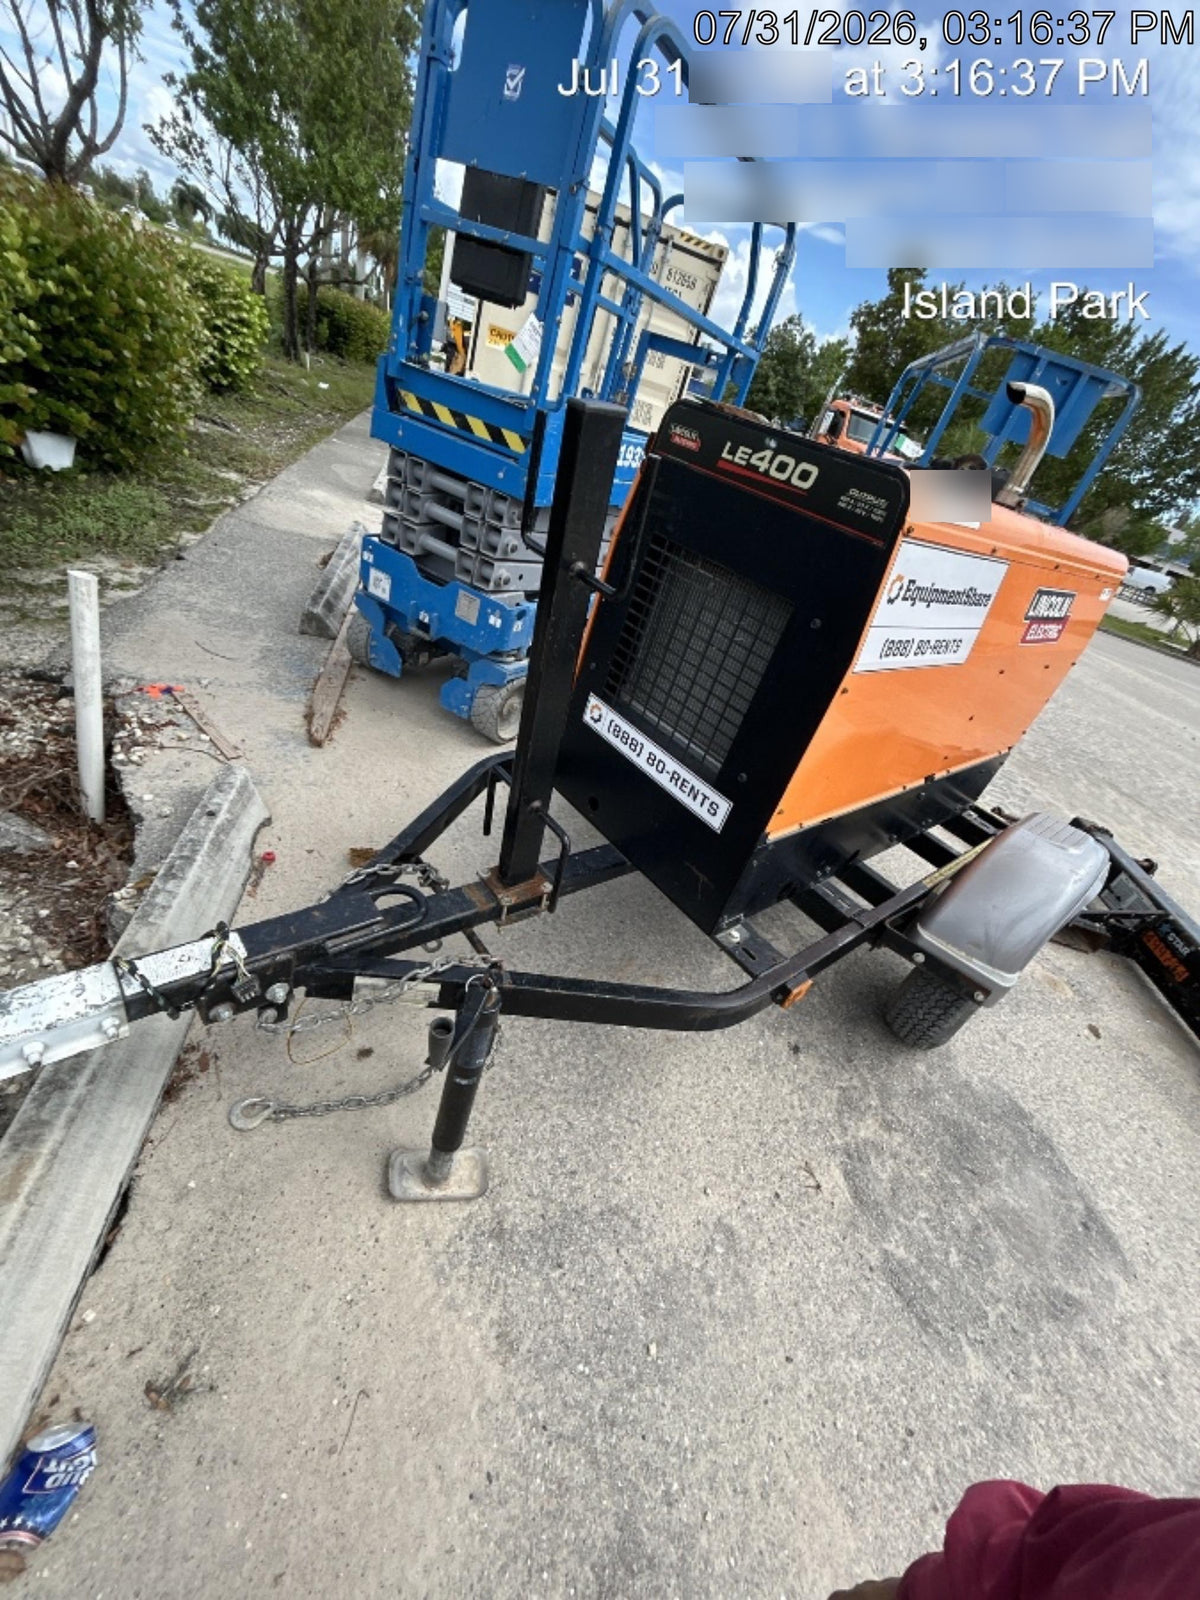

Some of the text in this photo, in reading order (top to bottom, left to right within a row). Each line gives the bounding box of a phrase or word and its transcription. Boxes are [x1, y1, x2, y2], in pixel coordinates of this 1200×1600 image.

[720, 440, 820, 491] LE400
[901, 578, 993, 609] EquipmentShare
[879, 637, 915, 660] (888)
[607, 718, 720, 817] (888) 80-RENTS
